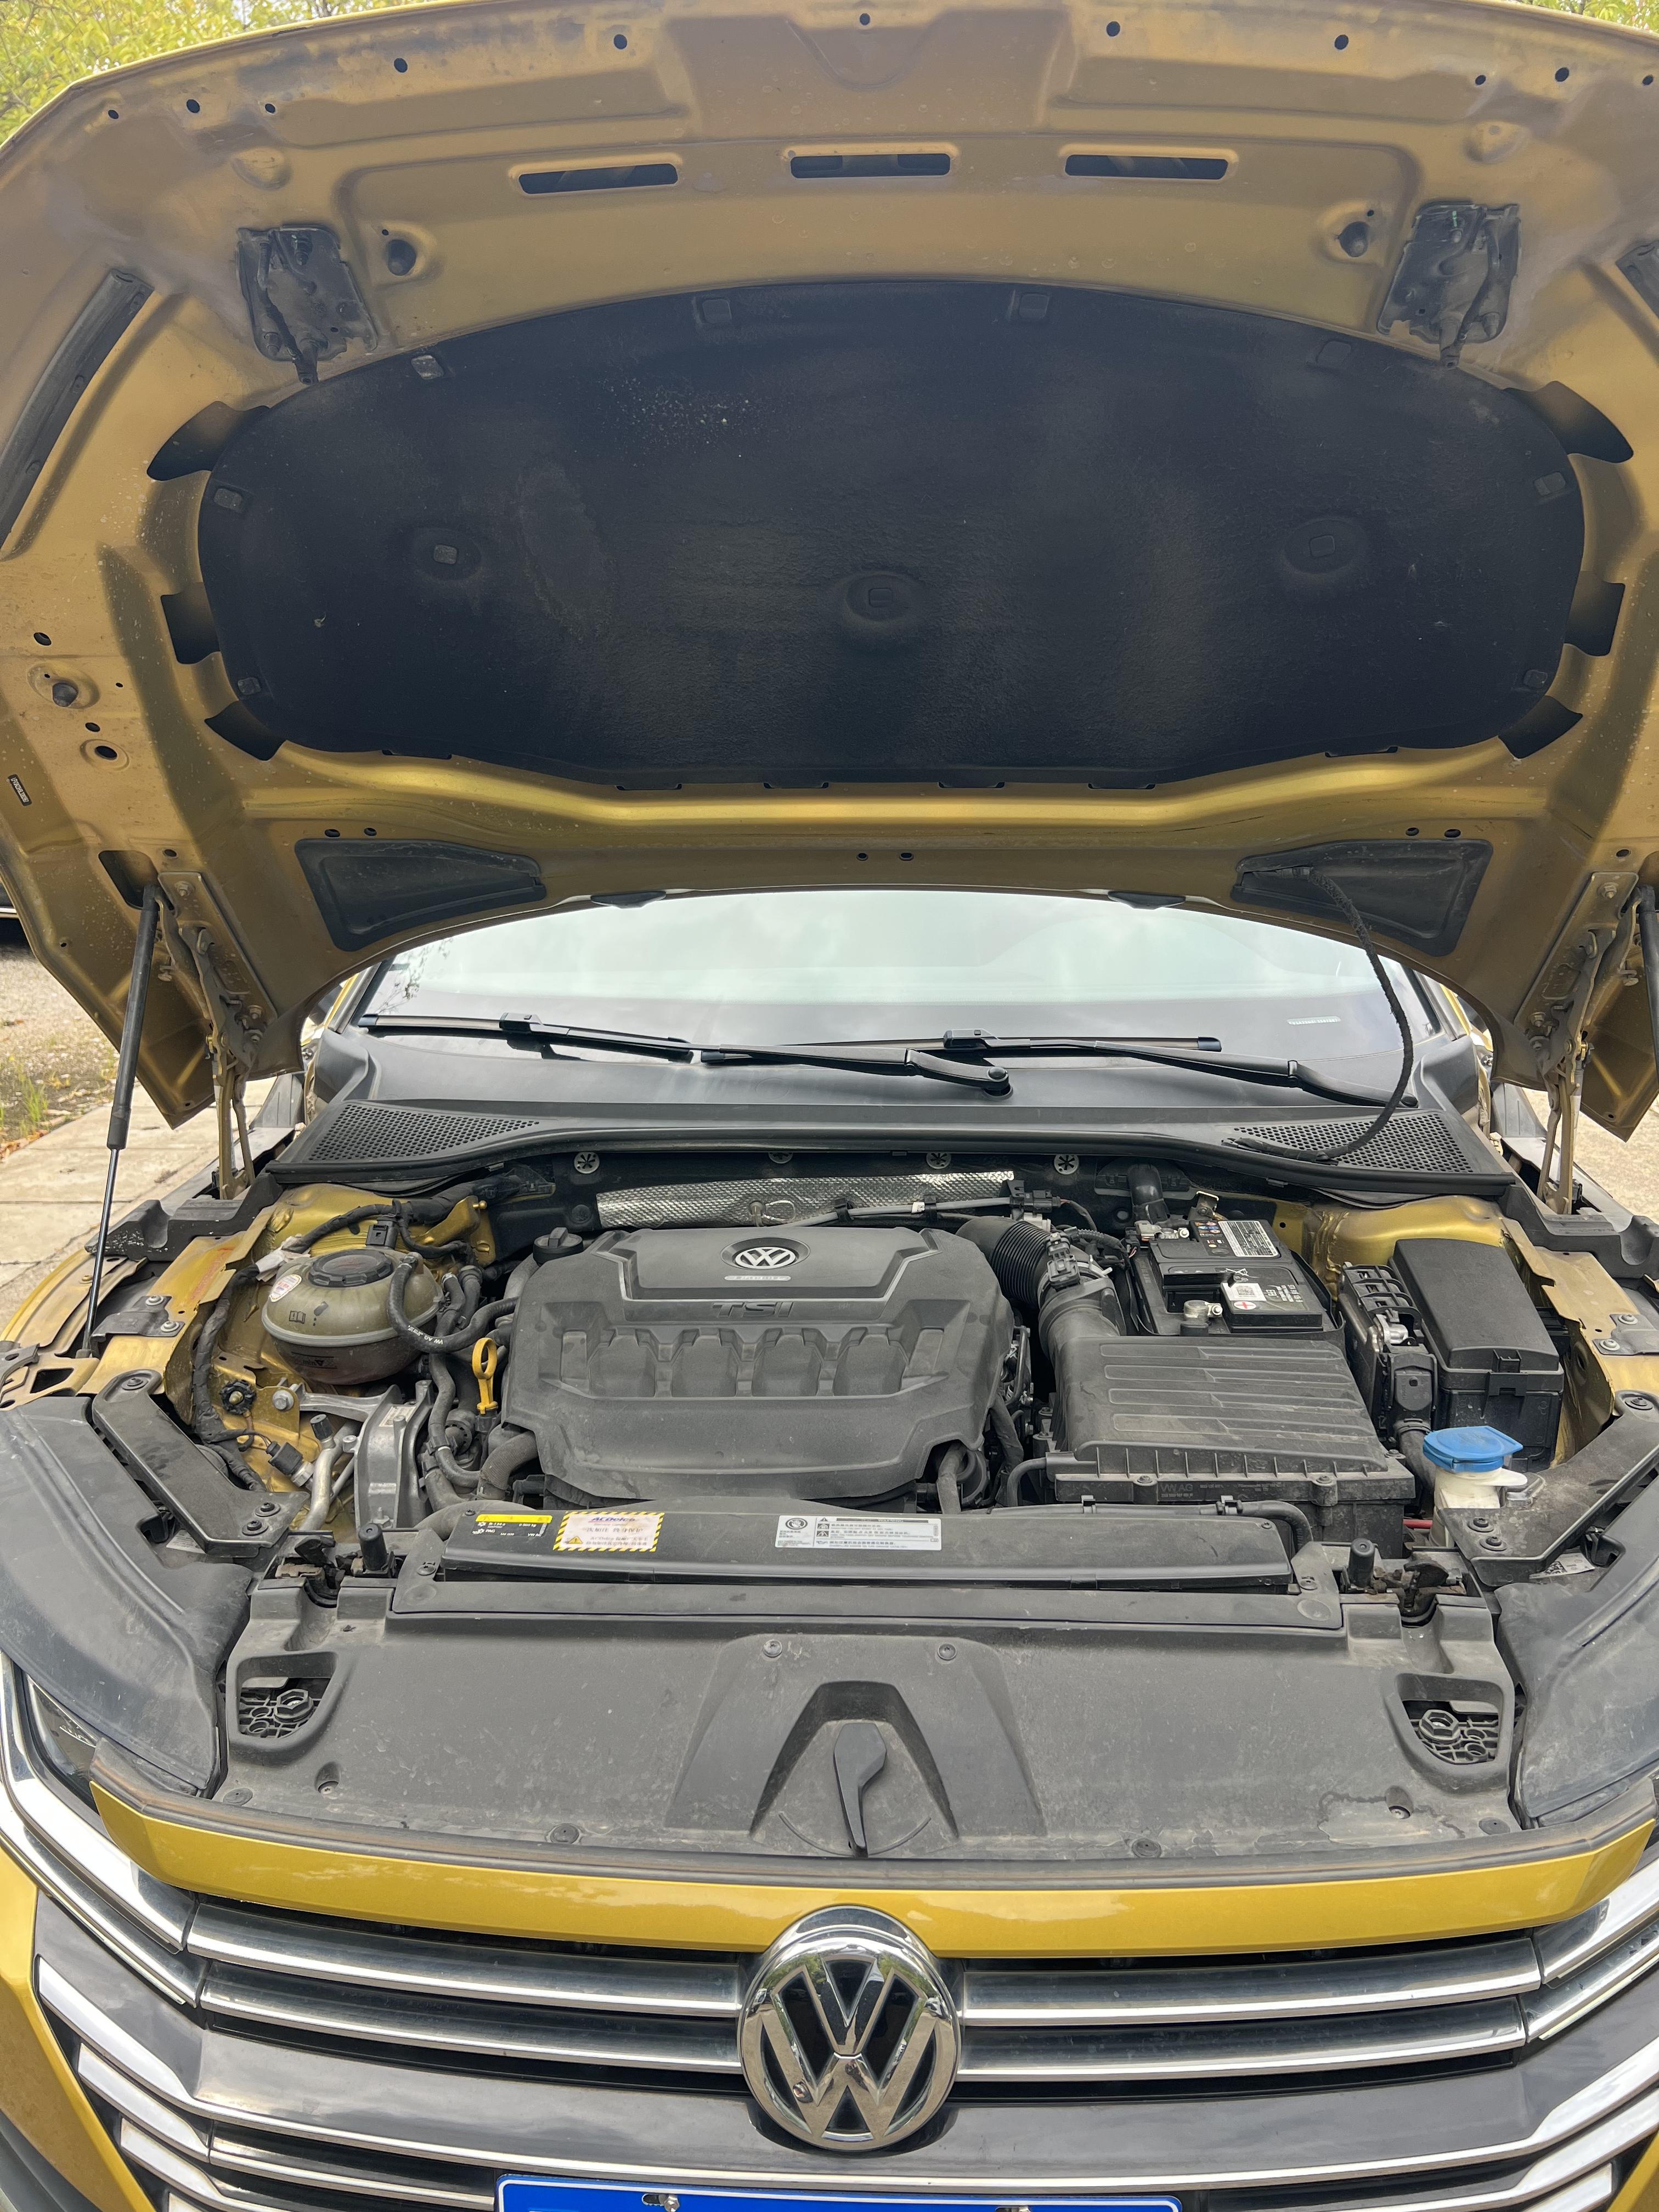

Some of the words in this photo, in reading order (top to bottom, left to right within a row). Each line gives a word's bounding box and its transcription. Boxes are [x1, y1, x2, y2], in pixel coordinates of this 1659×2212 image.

[712, 1301, 794, 1317] TSI
[1160, 1484, 1177, 1492] VW
[1178, 1483, 1194, 1492] AG
